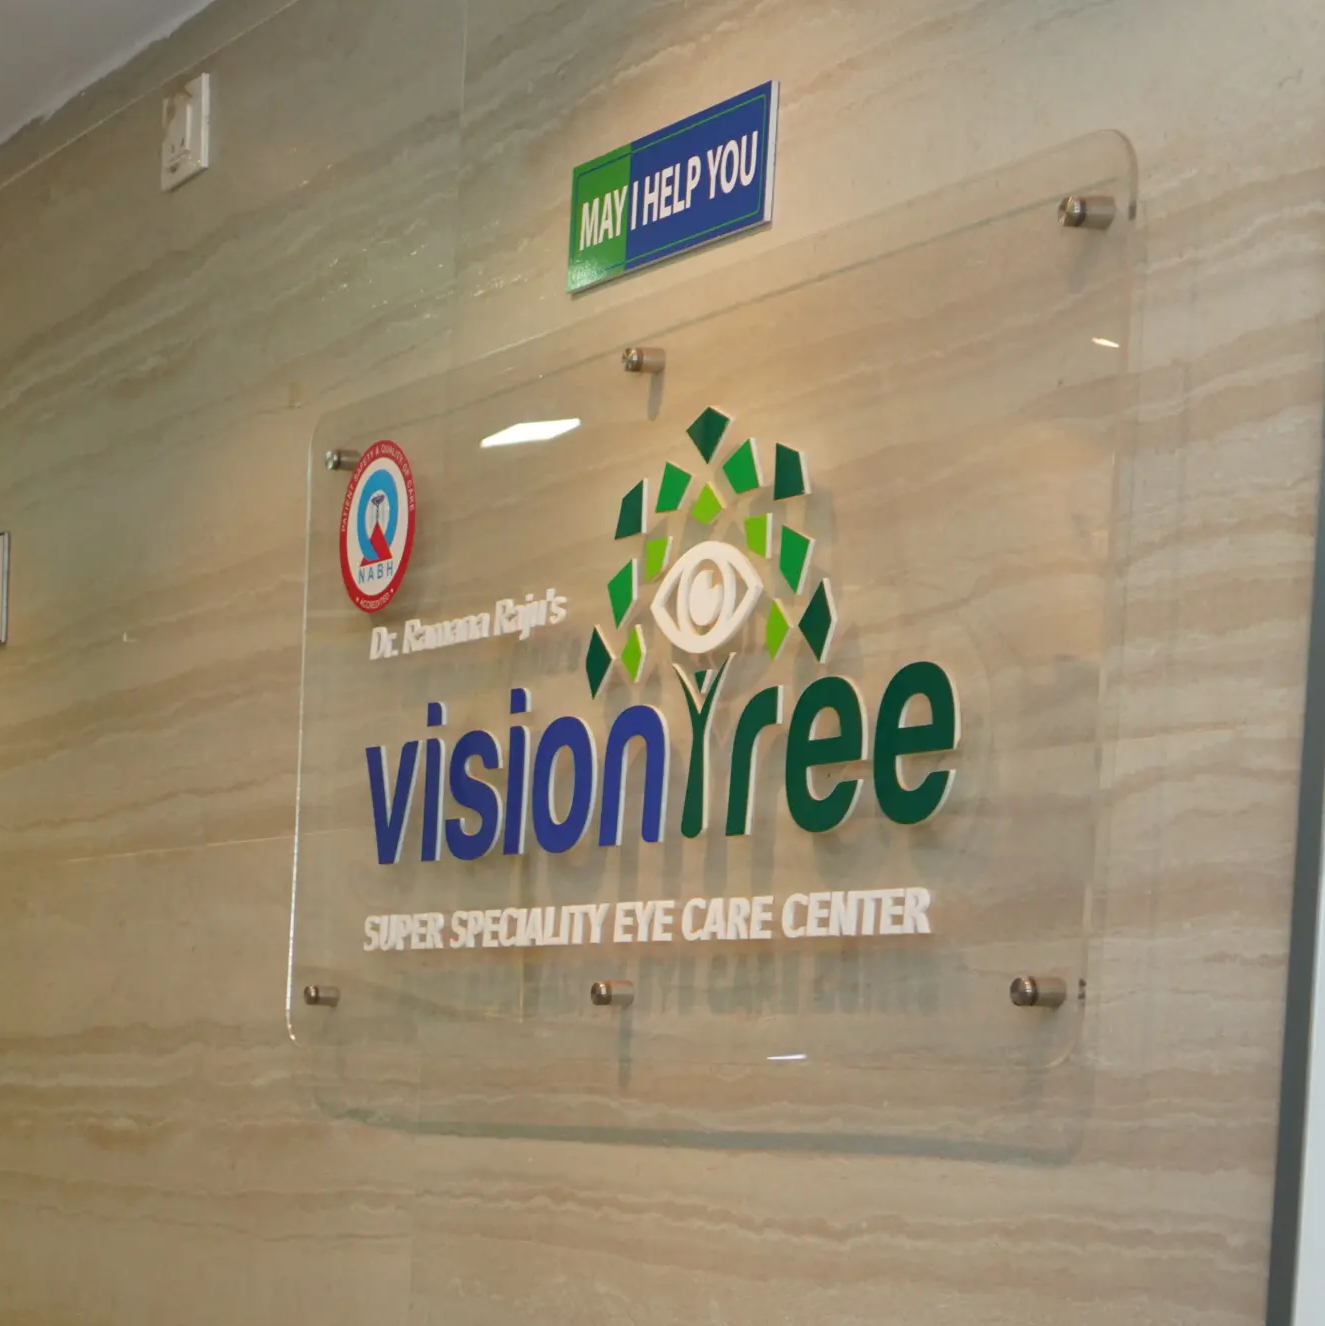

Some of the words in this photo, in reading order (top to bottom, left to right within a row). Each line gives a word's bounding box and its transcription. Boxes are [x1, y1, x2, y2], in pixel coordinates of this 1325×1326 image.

[579, 185, 628, 251] MAY
[630, 180, 639, 231] I
[642, 155, 702, 226] HELP
[706, 130, 759, 200] YOU
[341, 483, 355, 532] PATIENT
[354, 448, 374, 482] SAFETY
[381, 444, 403, 464] QUALITY
[402, 462, 410, 477] OF
[407, 480, 415, 511] CARE
[358, 561, 394, 585] NABH
[359, 591, 390, 609] ACCREDITED
[369, 626, 398, 660] Dr.
[402, 612, 491, 655] Ramana
[494, 588, 567, 641] Raju's
[365, 652, 961, 865] visionTree
[363, 911, 445, 951] SUPER
[450, 903, 610, 948] SPECIALITY
[613, 899, 675, 943] EYE
[681, 896, 774, 942] CARE
[781, 887, 932, 939] CENTER
